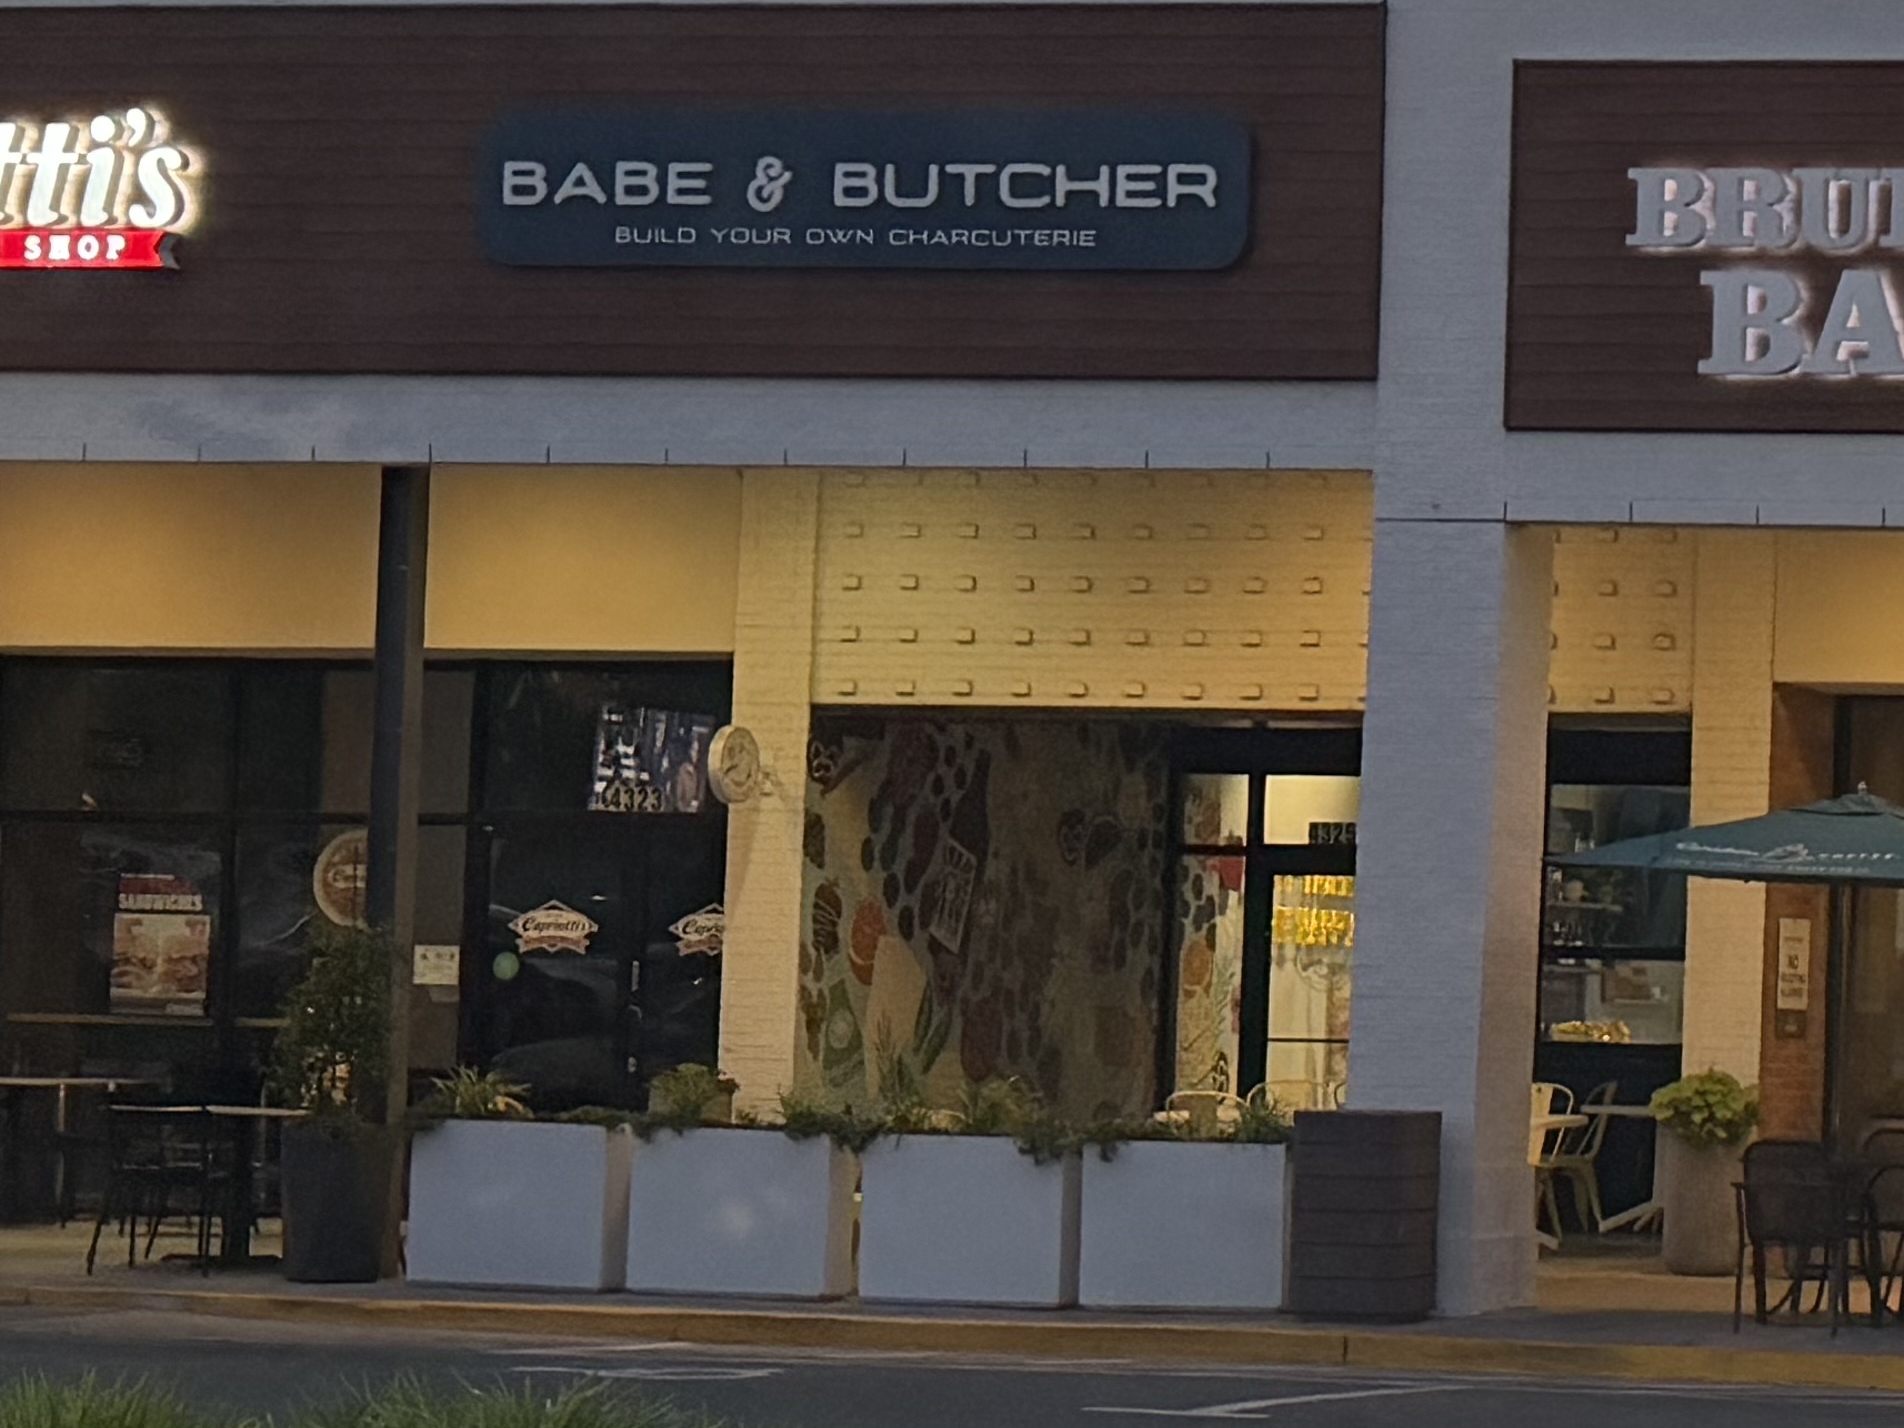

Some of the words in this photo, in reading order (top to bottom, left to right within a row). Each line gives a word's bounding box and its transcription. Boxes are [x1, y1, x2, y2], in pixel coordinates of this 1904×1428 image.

[503, 160, 713, 206] BABE
[747, 156, 793, 212] &
[834, 162, 1218, 208] BUTCHER
[24, 234, 126, 260] SHOP
[615, 226, 696, 244] BUILD
[711, 227, 792, 245] YOUR
[806, 228, 874, 245] OWN
[888, 228, 1096, 247] CHARCUTERIE
